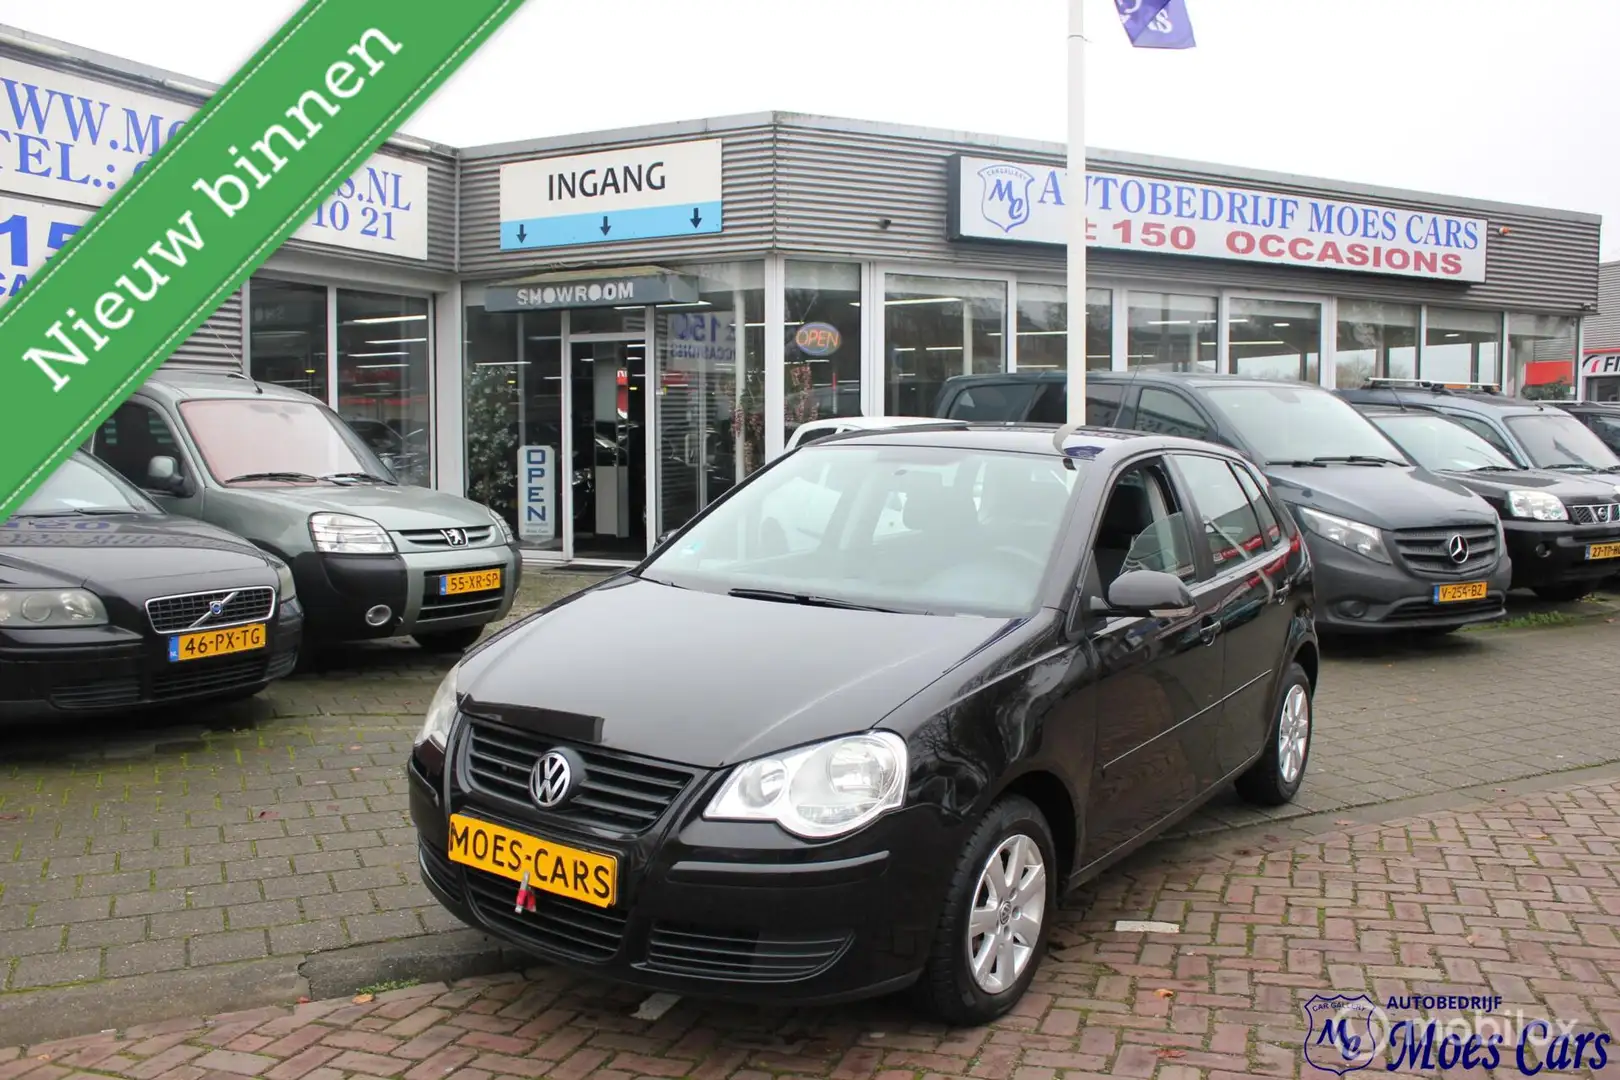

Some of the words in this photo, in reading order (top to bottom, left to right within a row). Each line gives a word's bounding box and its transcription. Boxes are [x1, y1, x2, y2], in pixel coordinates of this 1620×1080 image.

[547, 161, 666, 201] INGANG
[360, 207, 396, 241] 21
[1037, 170, 1299, 229] ATOBEDRIJF
[1308, 202, 1396, 242] MOES
[1406, 214, 1479, 250] CARS
[1112, 219, 1196, 250] 150
[1226, 230, 1462, 275] OCCASIONS
[516, 282, 634, 306] SHOWROOM
[795, 328, 839, 349] OPEN
[527, 449, 546, 522] OPEN
[451, 572, 499, 591] 55-XR-SP
[1441, 584, 1483, 600] V-254-BZ
[185, 628, 260, 655] 46-PX-TG
[450, 821, 612, 900] MOES-CARS
